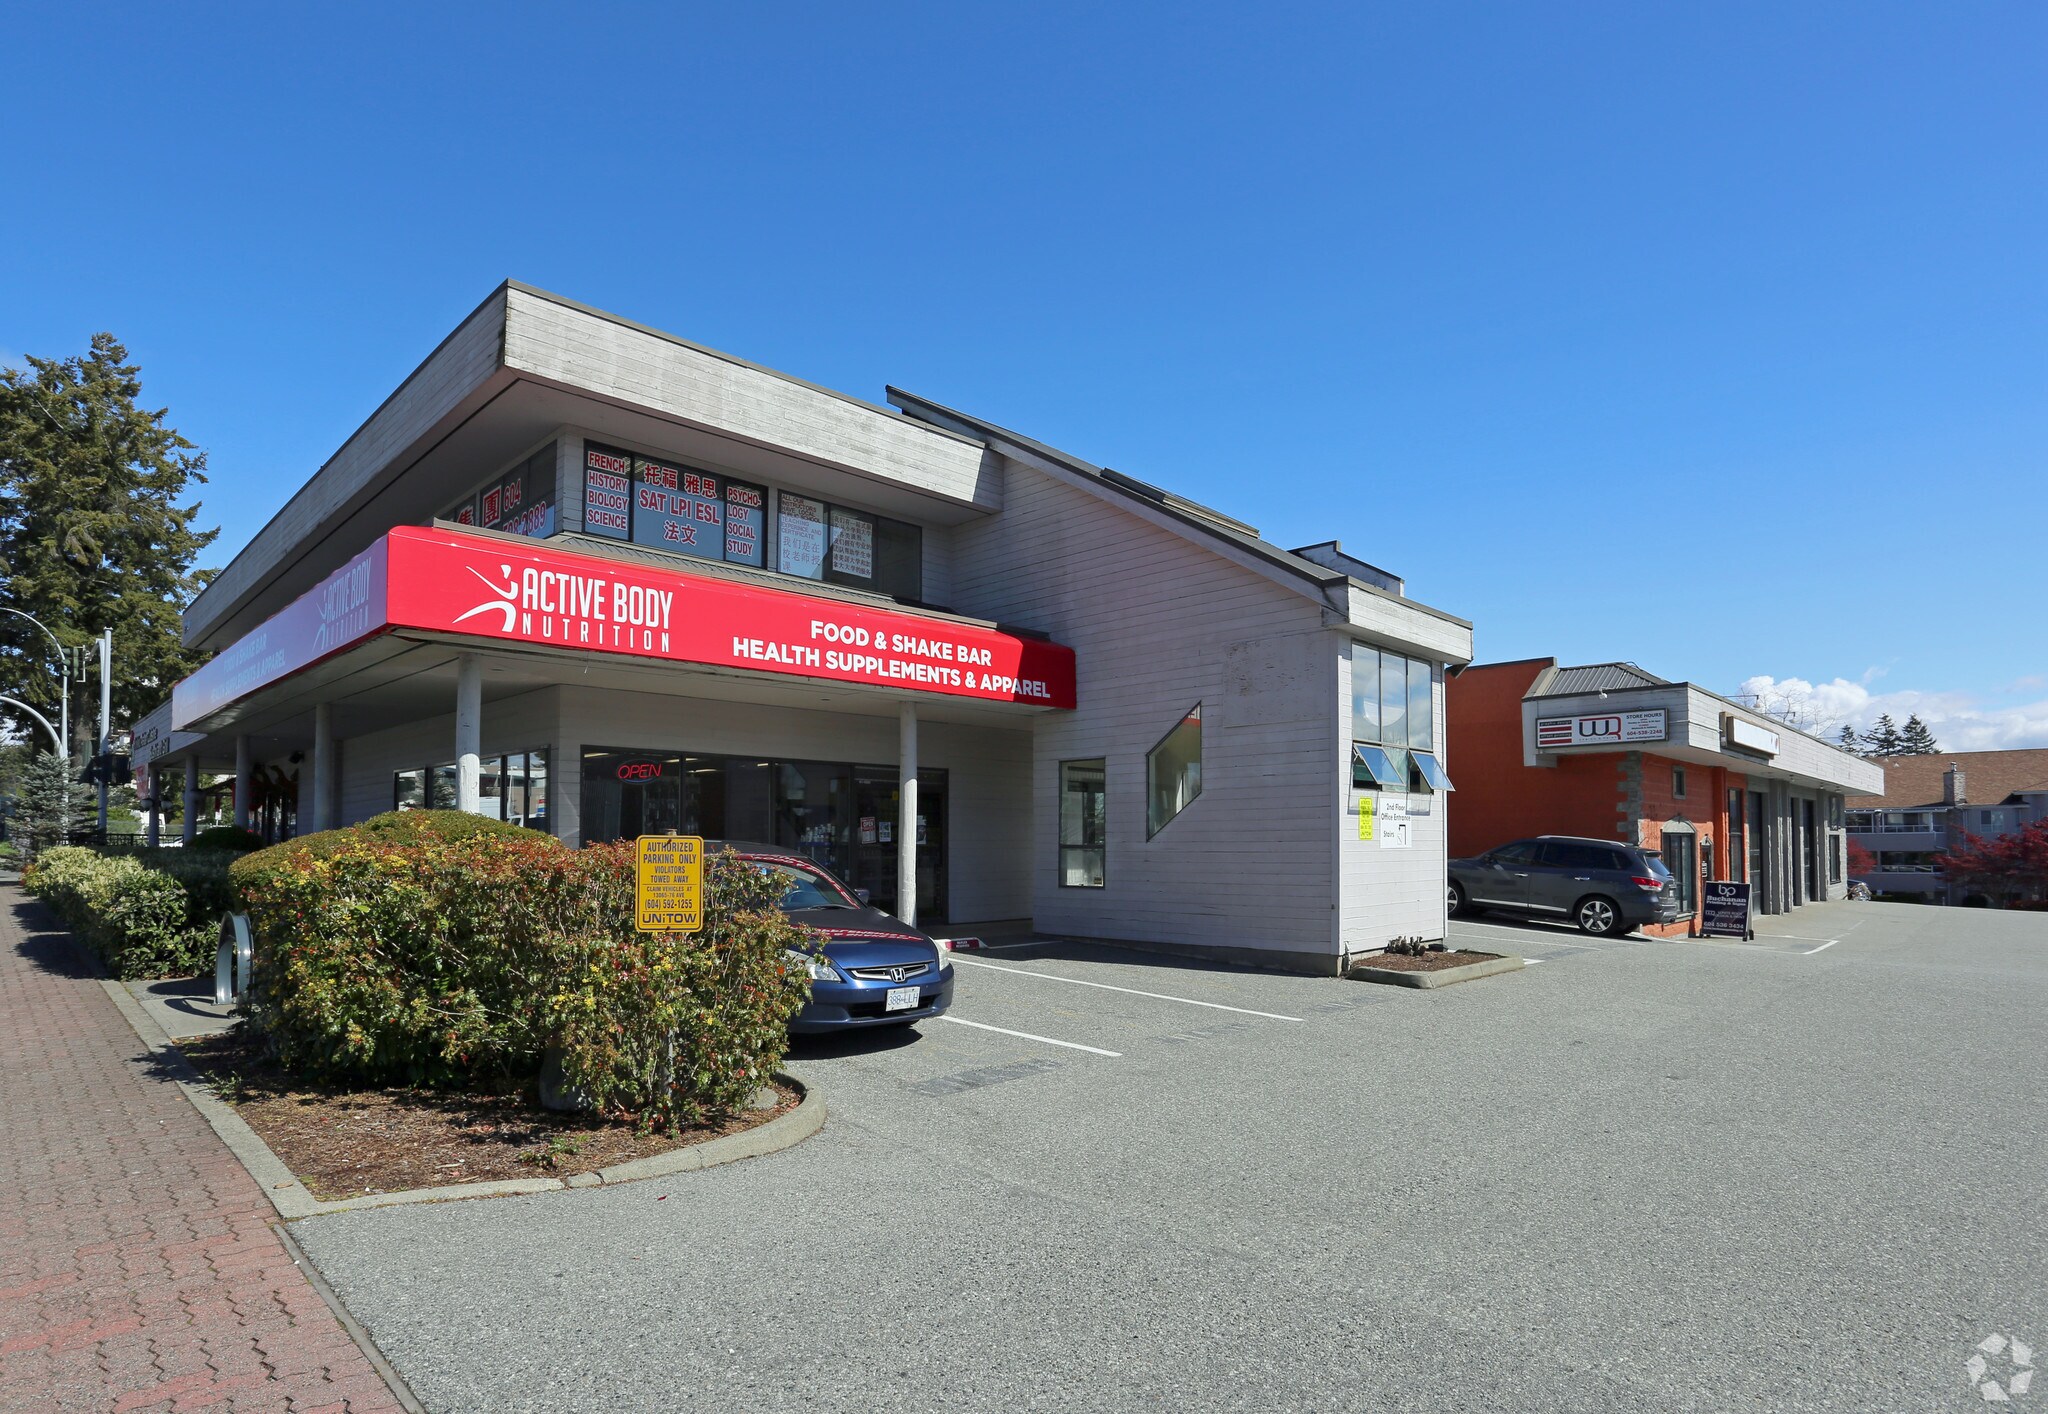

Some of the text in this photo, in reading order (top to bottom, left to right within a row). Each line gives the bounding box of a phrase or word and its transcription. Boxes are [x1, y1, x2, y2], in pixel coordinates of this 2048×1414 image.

[588, 452, 625, 474] FRENCH
[588, 470, 628, 492] HISTORY
[644, 464, 716, 498] 托福 雅思
[504, 479, 521, 512] 604
[588, 490, 628, 511] BIOLOGY
[728, 486, 760, 506] PSYCHO-
[640, 489, 720, 525] SAT LPI ESL
[728, 504, 748, 520] LOGY
[588, 508, 626, 530] SCIENCE
[664, 520, 696, 546] 法文
[727, 522, 755, 540] SOCIAL
[782, 528, 814, 539] CERTIFICATE
[727, 540, 754, 556] STUDY
[326, 558, 372, 624] ACTIVE BODY
[522, 568, 673, 629] ACTIVE BODY
[522, 613, 669, 652] NUTRITION
[810, 620, 992, 667] FOOD & SHAKE BAR
[732, 636, 1050, 698] HEALTH SUPPLEMENTS & APPAREL
[618, 764, 662, 778] OPEN
[647, 842, 693, 852] AUTHORIZED
[644, 854, 696, 864] PARKING ONLY
[645, 899, 692, 910] (604) 592-1255
